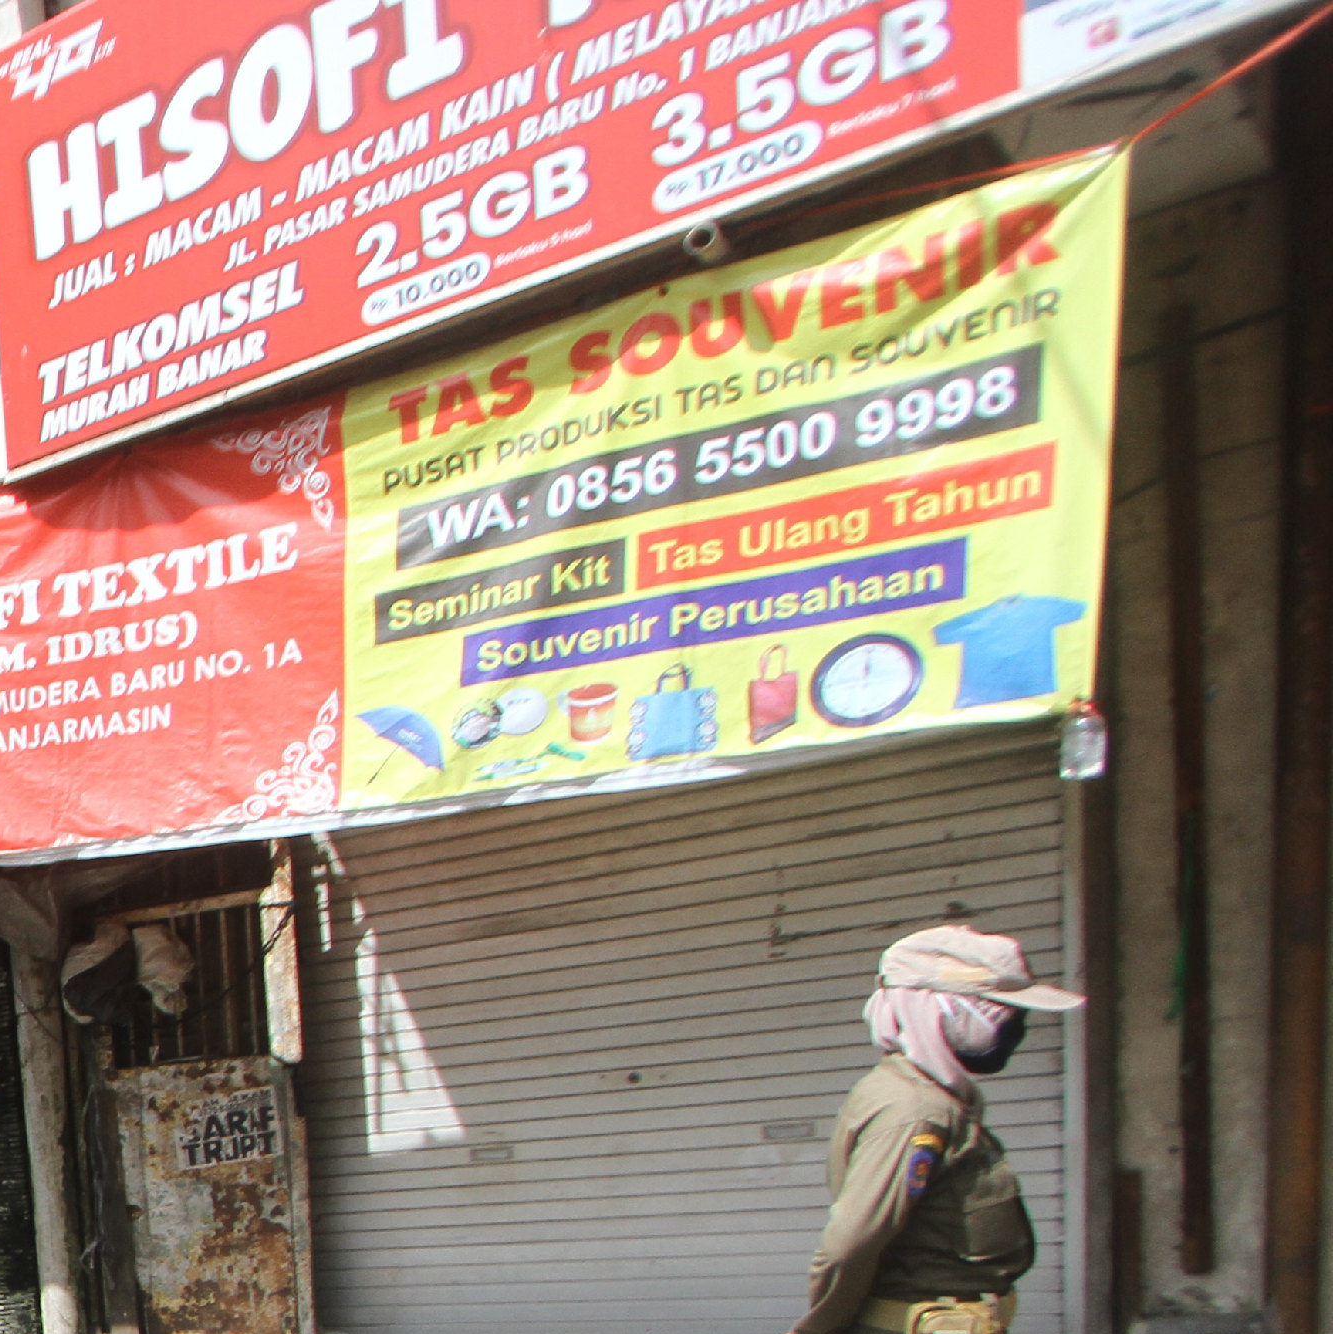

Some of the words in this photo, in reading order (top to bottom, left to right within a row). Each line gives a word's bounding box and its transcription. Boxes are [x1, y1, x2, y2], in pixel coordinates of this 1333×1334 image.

[11, 18, 103, 102] 4G
[651, 0, 952, 167] 3.5GB
[27, 0, 465, 261] HISOFI
[48, 250, 118, 310] JUAL
[142, 185, 262, 270] MACAM
[295, 111, 430, 205] MACAM
[439, 60, 535, 142] KAIN
[222, 237, 258, 273] JL.
[263, 197, 347, 256] PASAR
[352, 126, 511, 219] SAMUDERA
[516, 85, 606, 152] BARU
[611, 71, 668, 111] No.
[356, 145, 590, 289] 2.5GB
[38, 260, 305, 405] TELKOMSEL
[388, 356, 534, 445] TAS
[569, 202, 1060, 396] SOUVENIR
[395, 260, 481, 309] 10.000
[39, 372, 153, 443] MURAH
[155, 329, 268, 400] BANAR
[383, 445, 486, 496] PUSAT
[495, 395, 663, 465] PRODUKSI
[674, 371, 743, 416] TAS
[755, 354, 836, 397] DAN
[850, 286, 1063, 373] SOUVENIR
[426, 490, 532, 550] WA:
[545, 448, 678, 518] 0856
[694, 410, 839, 486] 5500
[854, 364, 1021, 449] 9998
[646, 537, 725, 575] Tas
[738, 505, 871, 558] Ulang
[883, 468, 1043, 528] Tahun
[57, 521, 300, 619] TEXTILE
[387, 572, 542, 632] Seminar
[550, 553, 612, 596] Kit
[476, 611, 661, 673] Souvenir
[668, 562, 945, 638] Perusahaan
[46, 610, 199, 667] IDRUS)
[110, 660, 185, 698] BARU
[193, 649, 252, 684] NO.
[262, 637, 303, 670] 1A
